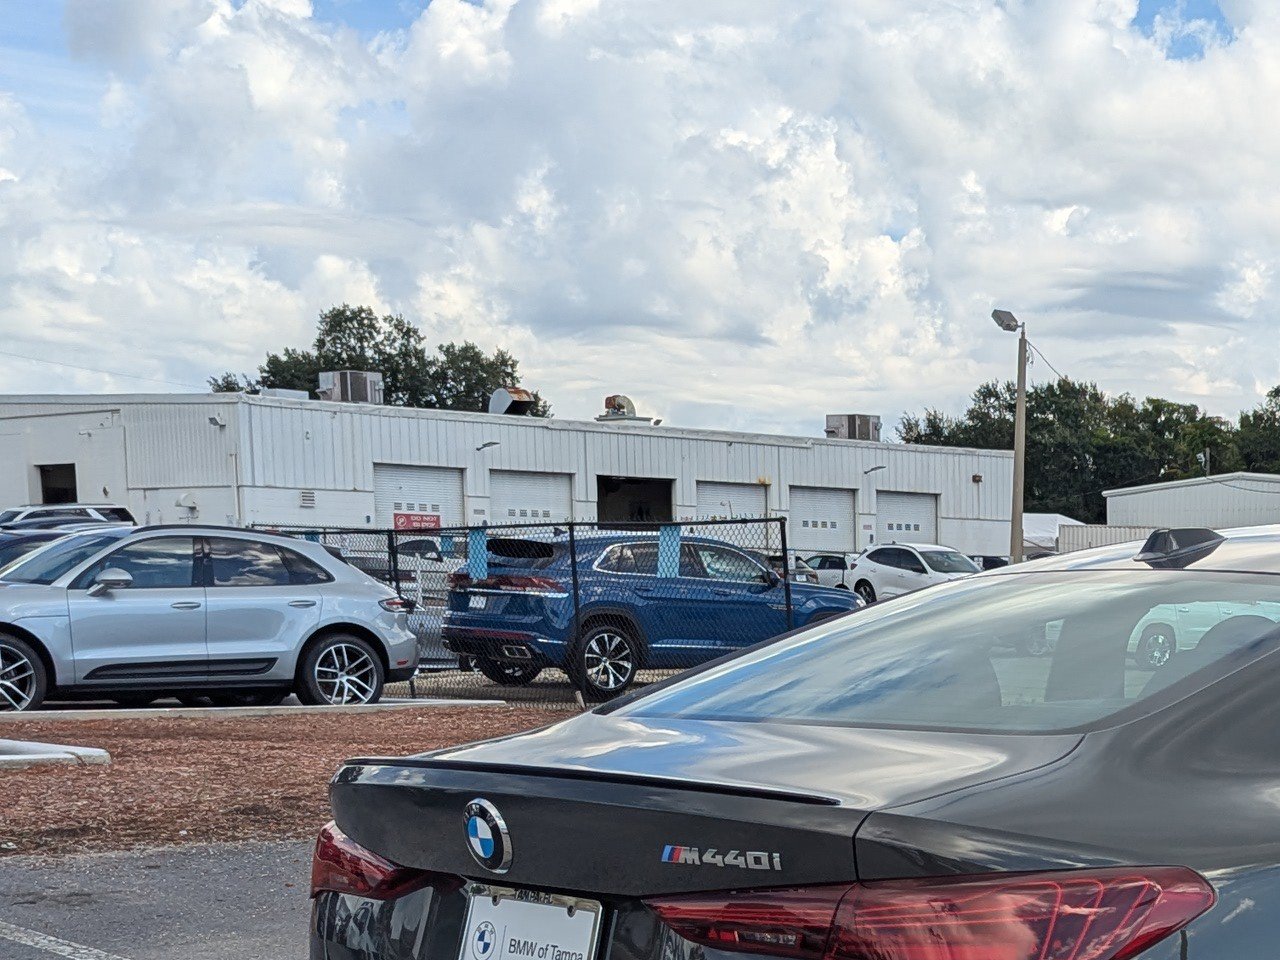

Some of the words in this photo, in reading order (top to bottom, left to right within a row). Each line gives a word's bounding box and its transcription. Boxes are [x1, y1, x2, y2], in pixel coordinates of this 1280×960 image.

[677, 845, 782, 871] M440i
[508, 938, 537, 957] BMW
[538, 944, 550, 959] of
